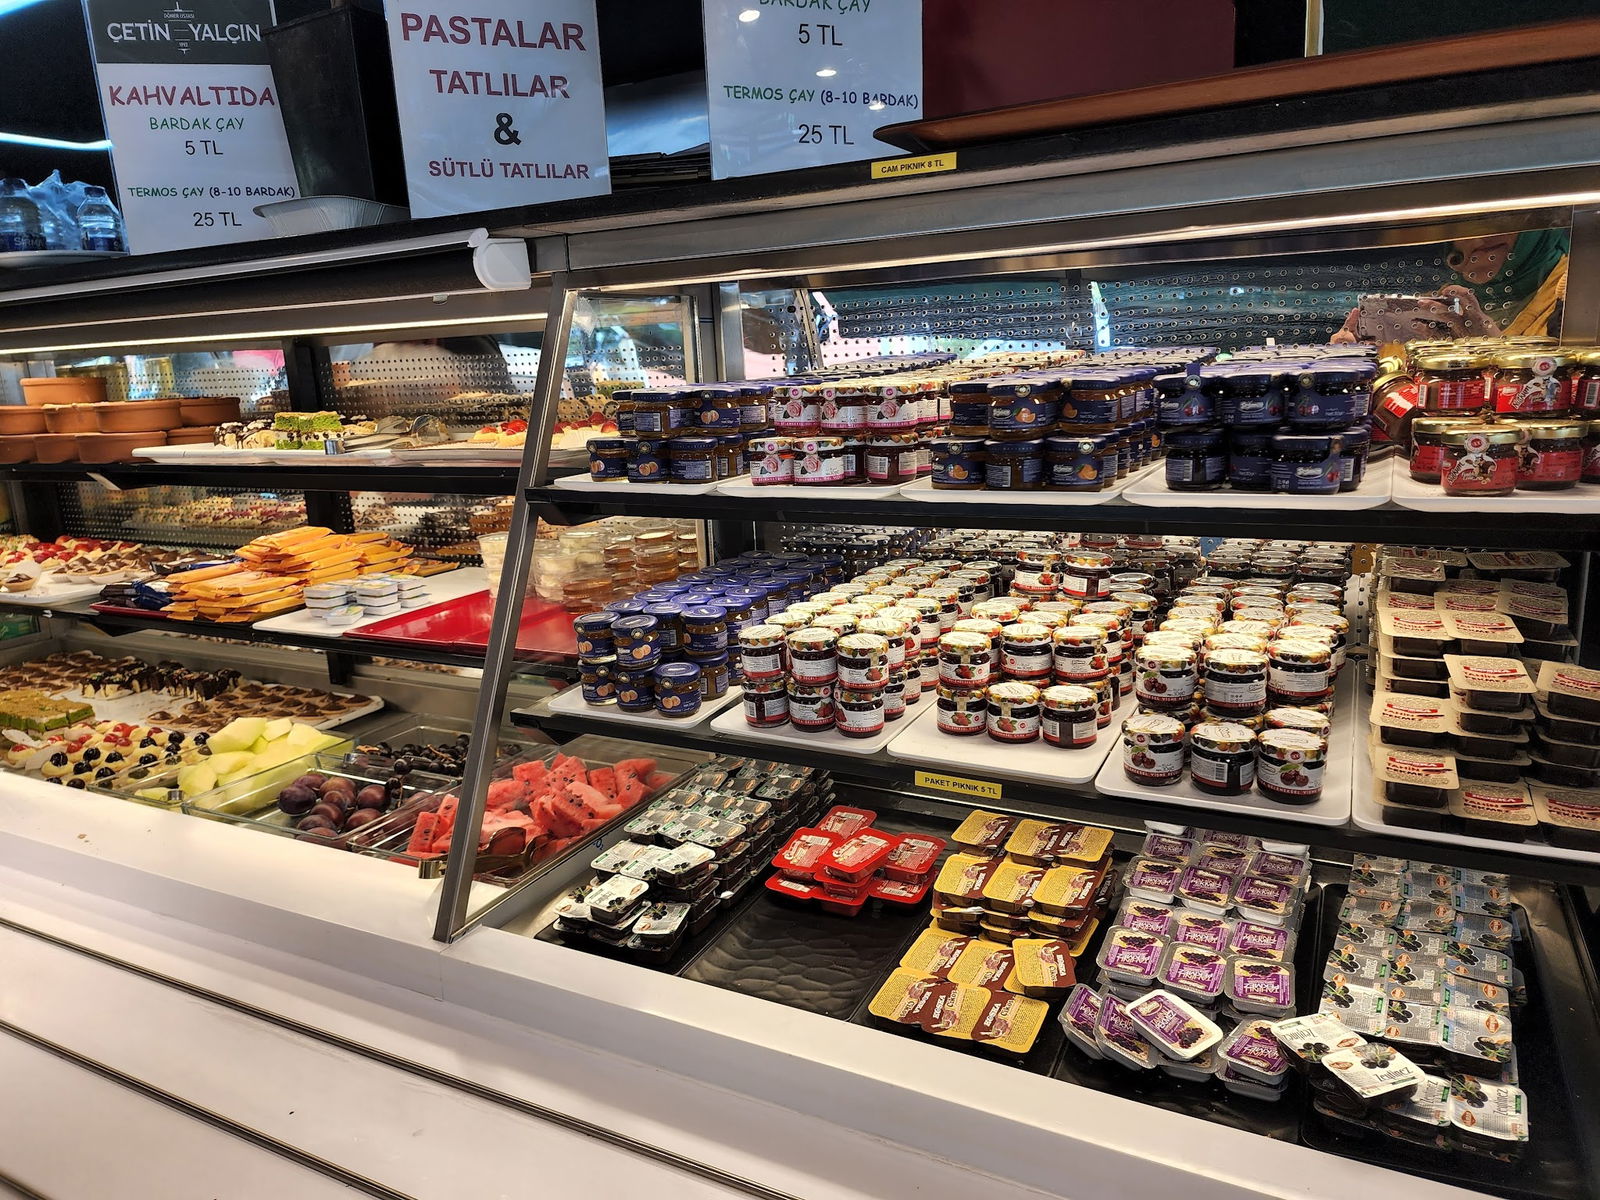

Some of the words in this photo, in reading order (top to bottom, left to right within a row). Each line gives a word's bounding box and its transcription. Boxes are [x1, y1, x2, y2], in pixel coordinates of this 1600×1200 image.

[106, 19, 171, 43] ÇETİN
[188, 23, 262, 44] YALÇIN
[401, 12, 587, 51] PASTALAR
[798, 23, 810, 44] 5
[816, 24, 843, 46] TL
[429, 69, 571, 99] TATLILAR
[108, 85, 276, 107] KAHVALTIDA
[723, 85, 784, 101] TERMOS
[788, 88, 815, 104] ÇAY
[820, 91, 857, 106] (8-10
[862, 91, 919, 109] BARDAK)
[149, 117, 212, 131] BARDAK
[215, 117, 244, 132] ÇAY
[494, 112, 522, 145] &
[798, 124, 823, 145] 25
[828, 125, 855, 146] TL
[185, 140, 196, 156] 5
[199, 140, 224, 156] TL
[428, 157, 494, 178] SÜTLÜ
[499, 162, 590, 180] TATLILAR
[881, 165, 899, 174] CAM
[900, 161, 926, 172] PIKNIK
[934, 159, 945, 167] TL
[127, 187, 178, 198] TERMOS
[182, 187, 204, 199] ÇAY
[209, 186, 242, 198] (8-10
[245, 186, 296, 199] BARDAK)
[192, 211, 215, 228] 25
[218, 211, 243, 227] TL
[924, 776, 951, 787] PAKET
[952, 780, 979, 793] PIKNIK
[986, 786, 998, 795] TL
